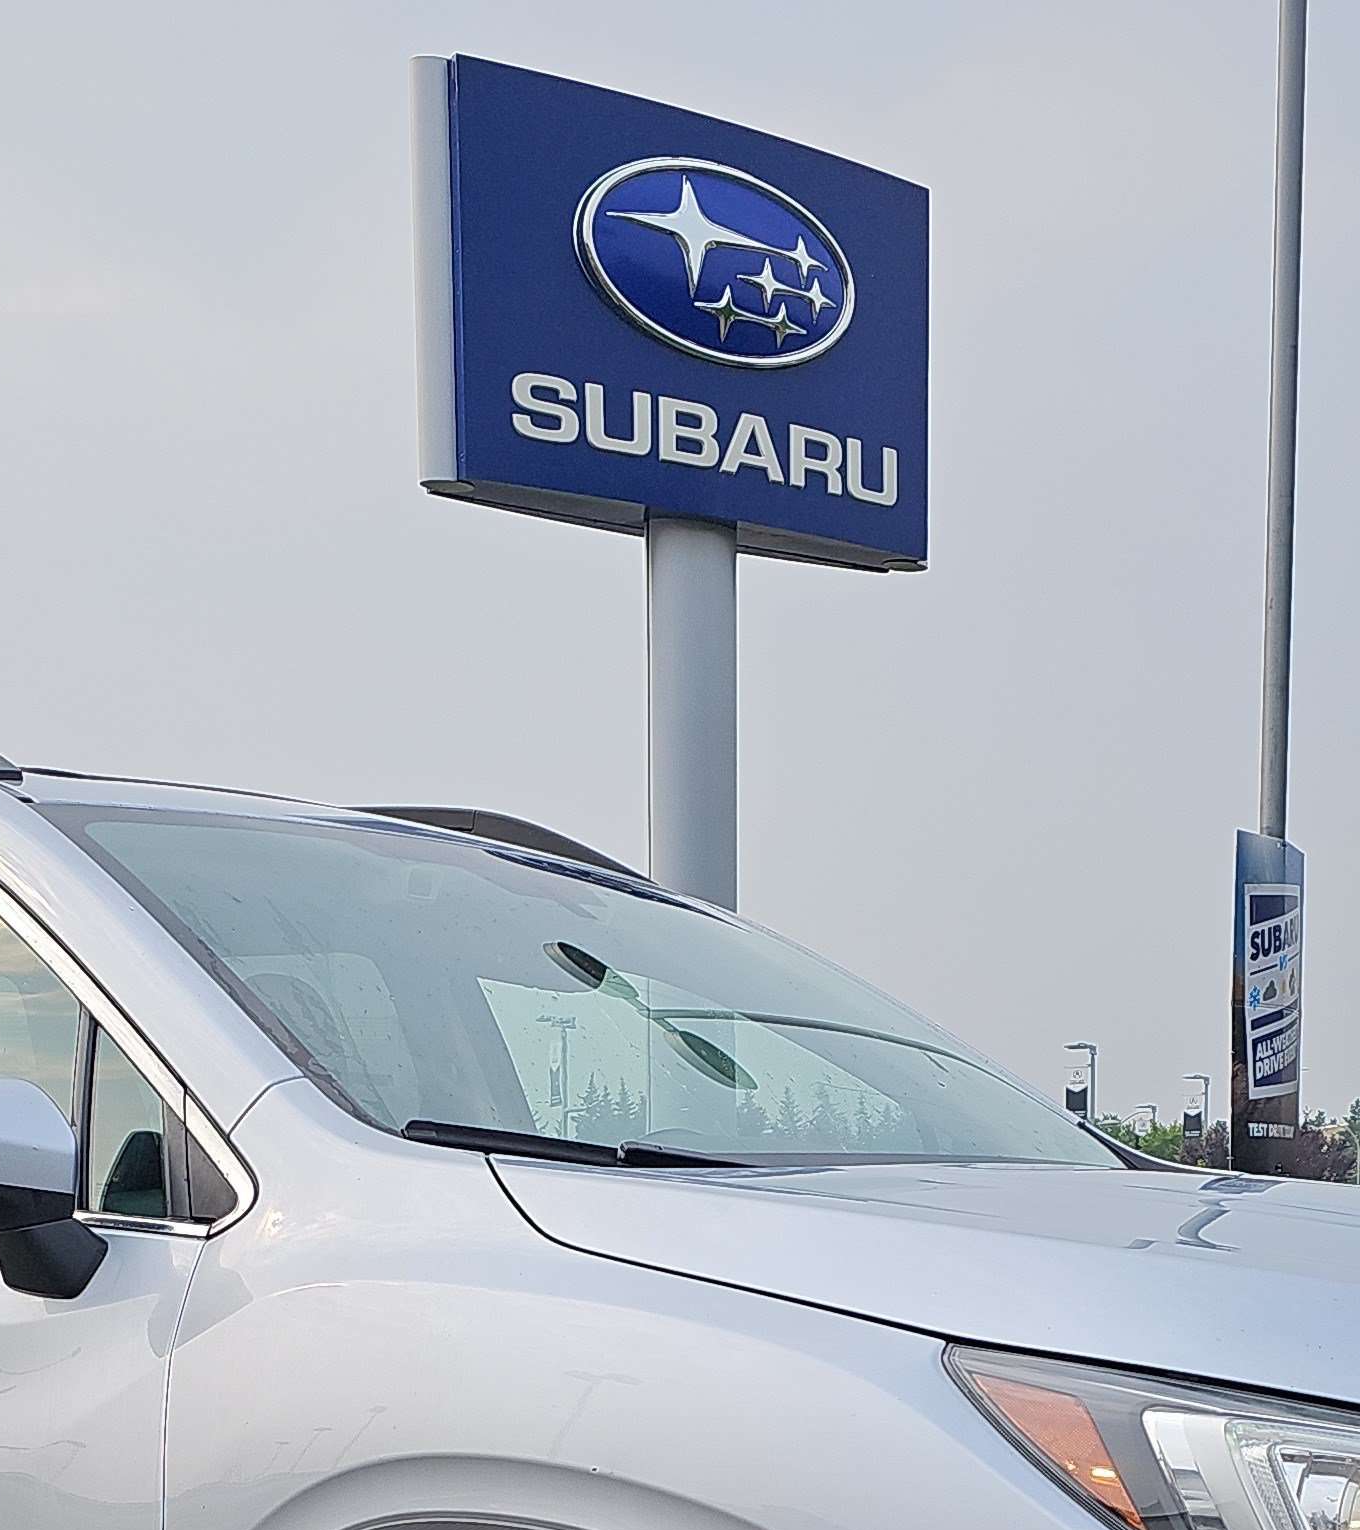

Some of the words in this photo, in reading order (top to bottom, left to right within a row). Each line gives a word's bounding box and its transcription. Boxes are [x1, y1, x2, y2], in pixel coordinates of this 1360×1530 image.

[510, 371, 899, 507] SUBARU
[1255, 1054, 1284, 1081] DRIVE
[1248, 1122, 1268, 1138] TEST
